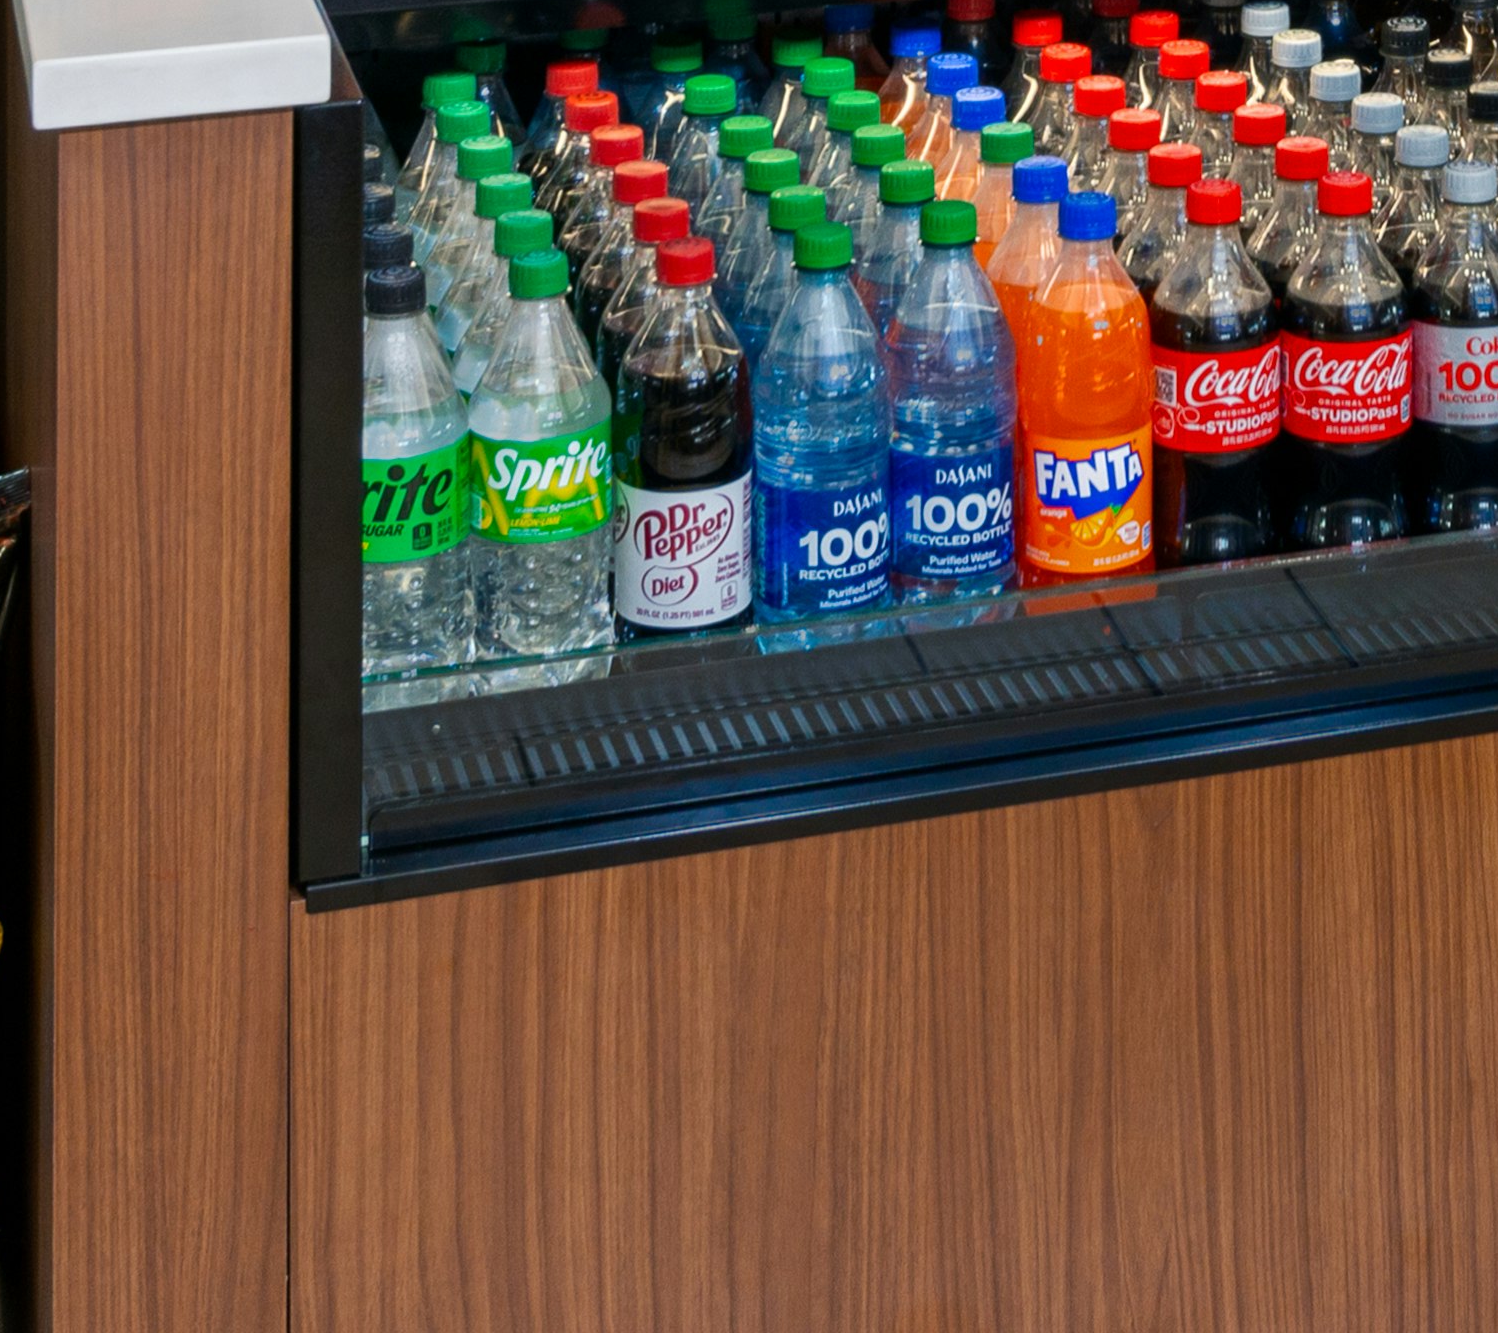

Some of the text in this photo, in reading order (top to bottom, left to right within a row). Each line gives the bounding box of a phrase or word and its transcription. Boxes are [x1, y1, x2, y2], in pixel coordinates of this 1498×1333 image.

[1184, 345, 1281, 408] Coca-Cola
[1294, 341, 1410, 395] Coca-Cola
[487, 437, 607, 501] Sprite
[935, 463, 992, 488] DASANI
[1035, 444, 1143, 499] FANTA
[667, 502, 706, 533] Dr
[833, 489, 883, 518] DASANI
[906, 482, 1013, 532] 100%
[634, 507, 728, 562] Pepper
[930, 549, 996, 566] Purified Water
[651, 575, 686, 597] Diet
